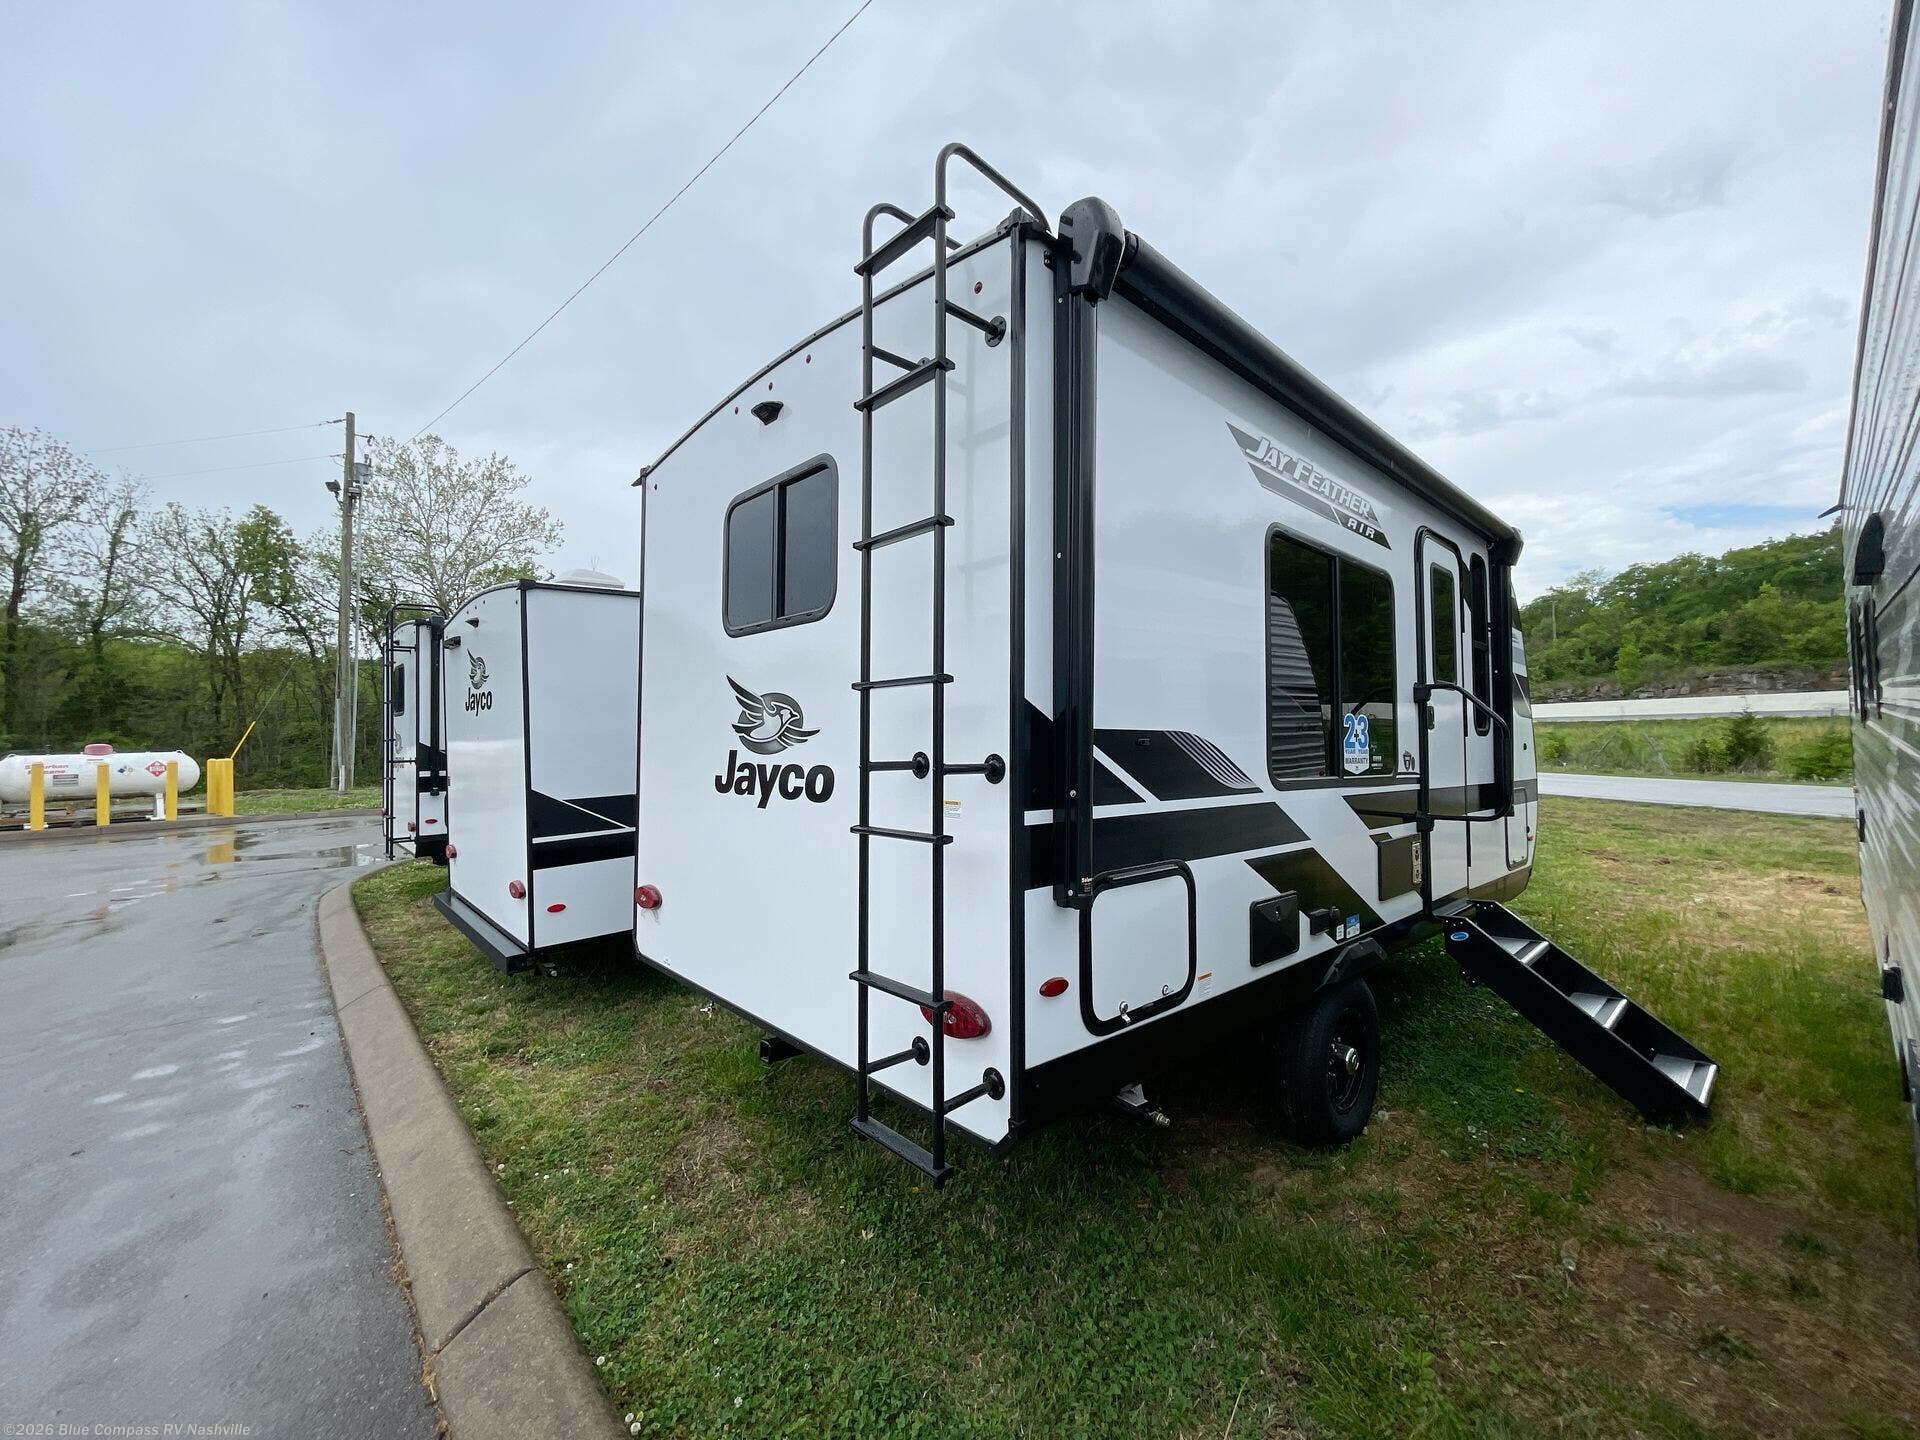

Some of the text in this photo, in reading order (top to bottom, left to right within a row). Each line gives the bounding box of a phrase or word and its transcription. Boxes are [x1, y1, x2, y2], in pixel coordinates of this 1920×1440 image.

[1245, 435, 1372, 520] JAY FEATHER
[1347, 517, 1376, 539] AIR
[464, 687, 493, 717] Jayco
[714, 749, 835, 809] Jayco
